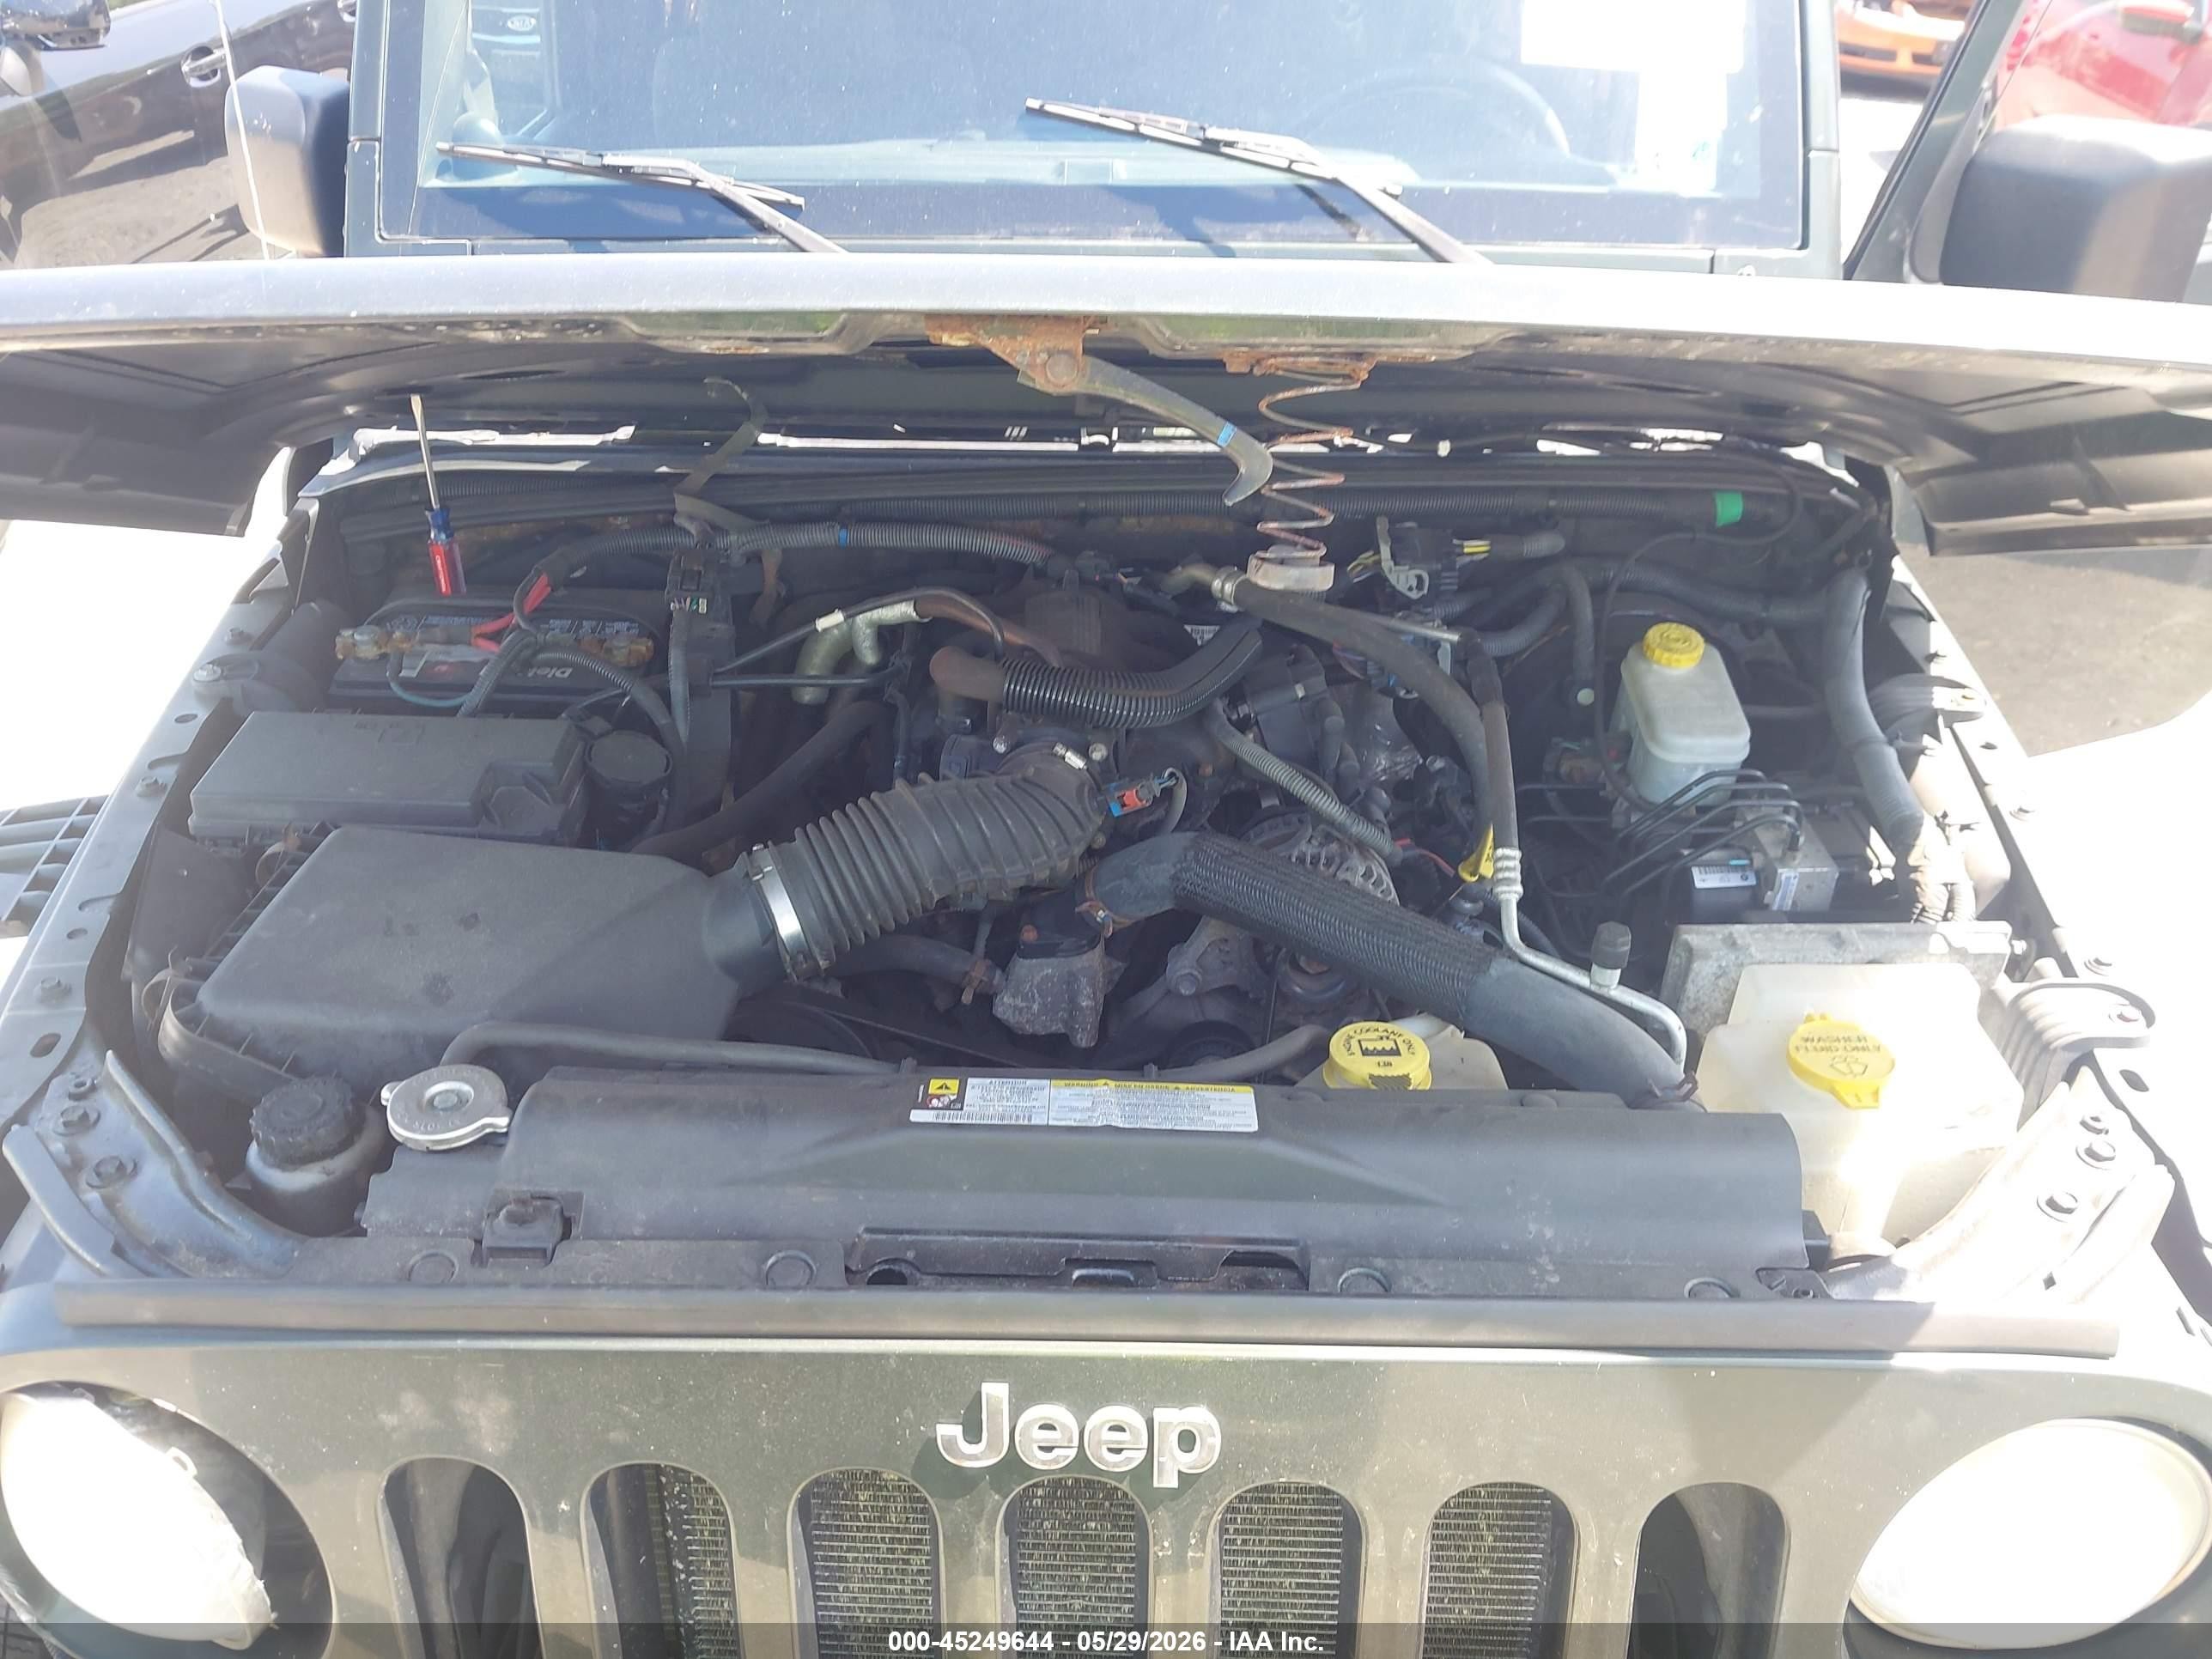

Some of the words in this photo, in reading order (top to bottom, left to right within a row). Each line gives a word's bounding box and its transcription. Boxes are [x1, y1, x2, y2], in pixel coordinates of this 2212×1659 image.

[1801, 1035, 1868, 1043] WASHER
[1795, 1044, 1840, 1053] FLUID
[1843, 1043, 1881, 1053] ONLY
[935, 1381, 1222, 1489] Jeep
